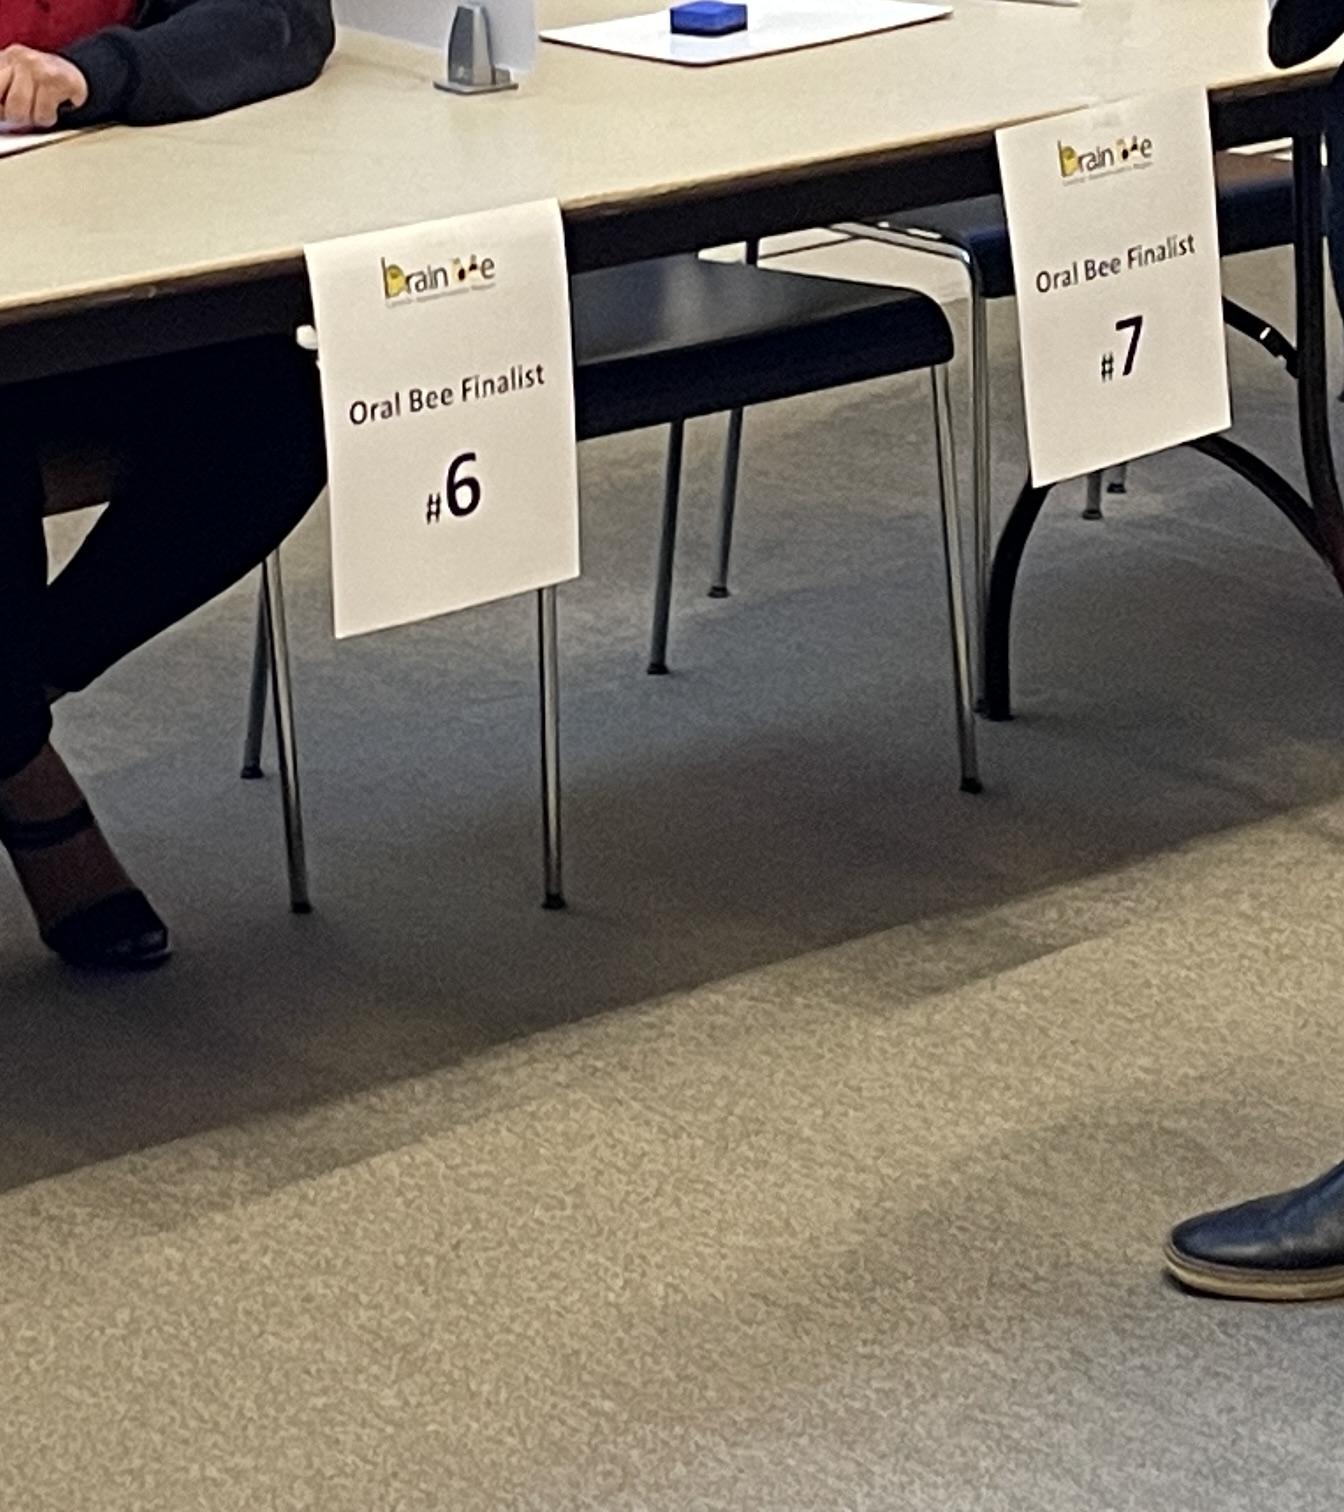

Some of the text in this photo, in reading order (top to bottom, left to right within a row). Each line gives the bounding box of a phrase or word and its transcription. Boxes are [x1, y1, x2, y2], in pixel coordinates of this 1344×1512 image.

[1035, 233, 1196, 294] Oral Bee Finalist
[1100, 314, 1144, 383] #7
[349, 363, 545, 426] Oral Bee Finalist
[425, 451, 482, 525] #6
